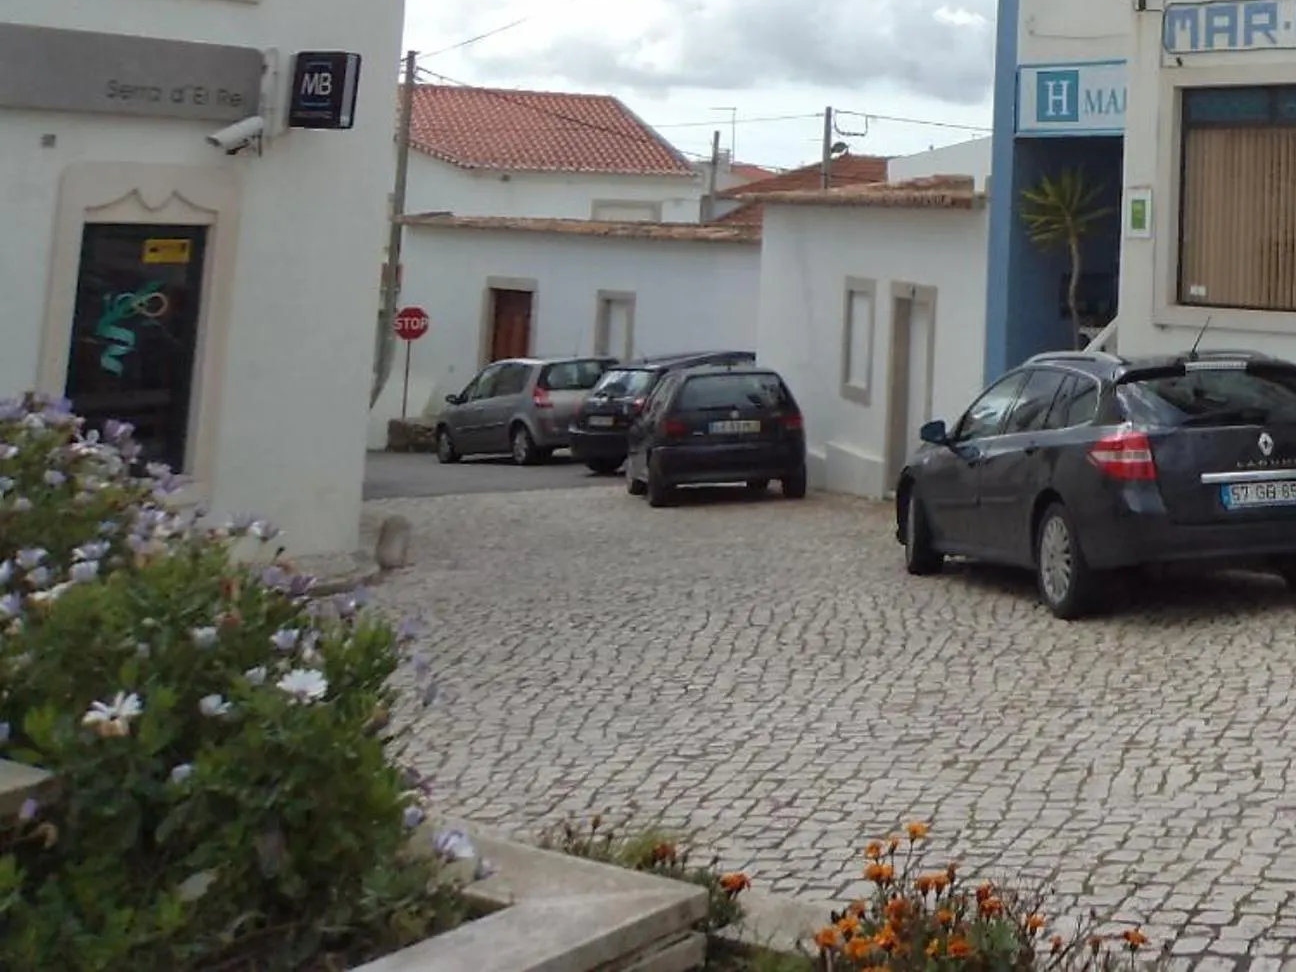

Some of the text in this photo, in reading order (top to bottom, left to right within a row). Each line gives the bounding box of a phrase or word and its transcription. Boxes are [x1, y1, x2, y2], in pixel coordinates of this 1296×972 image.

[106, 79, 162, 102] Serra
[300, 72, 332, 96] MB
[1045, 80, 1072, 116] H
[393, 317, 428, 331] STOP
